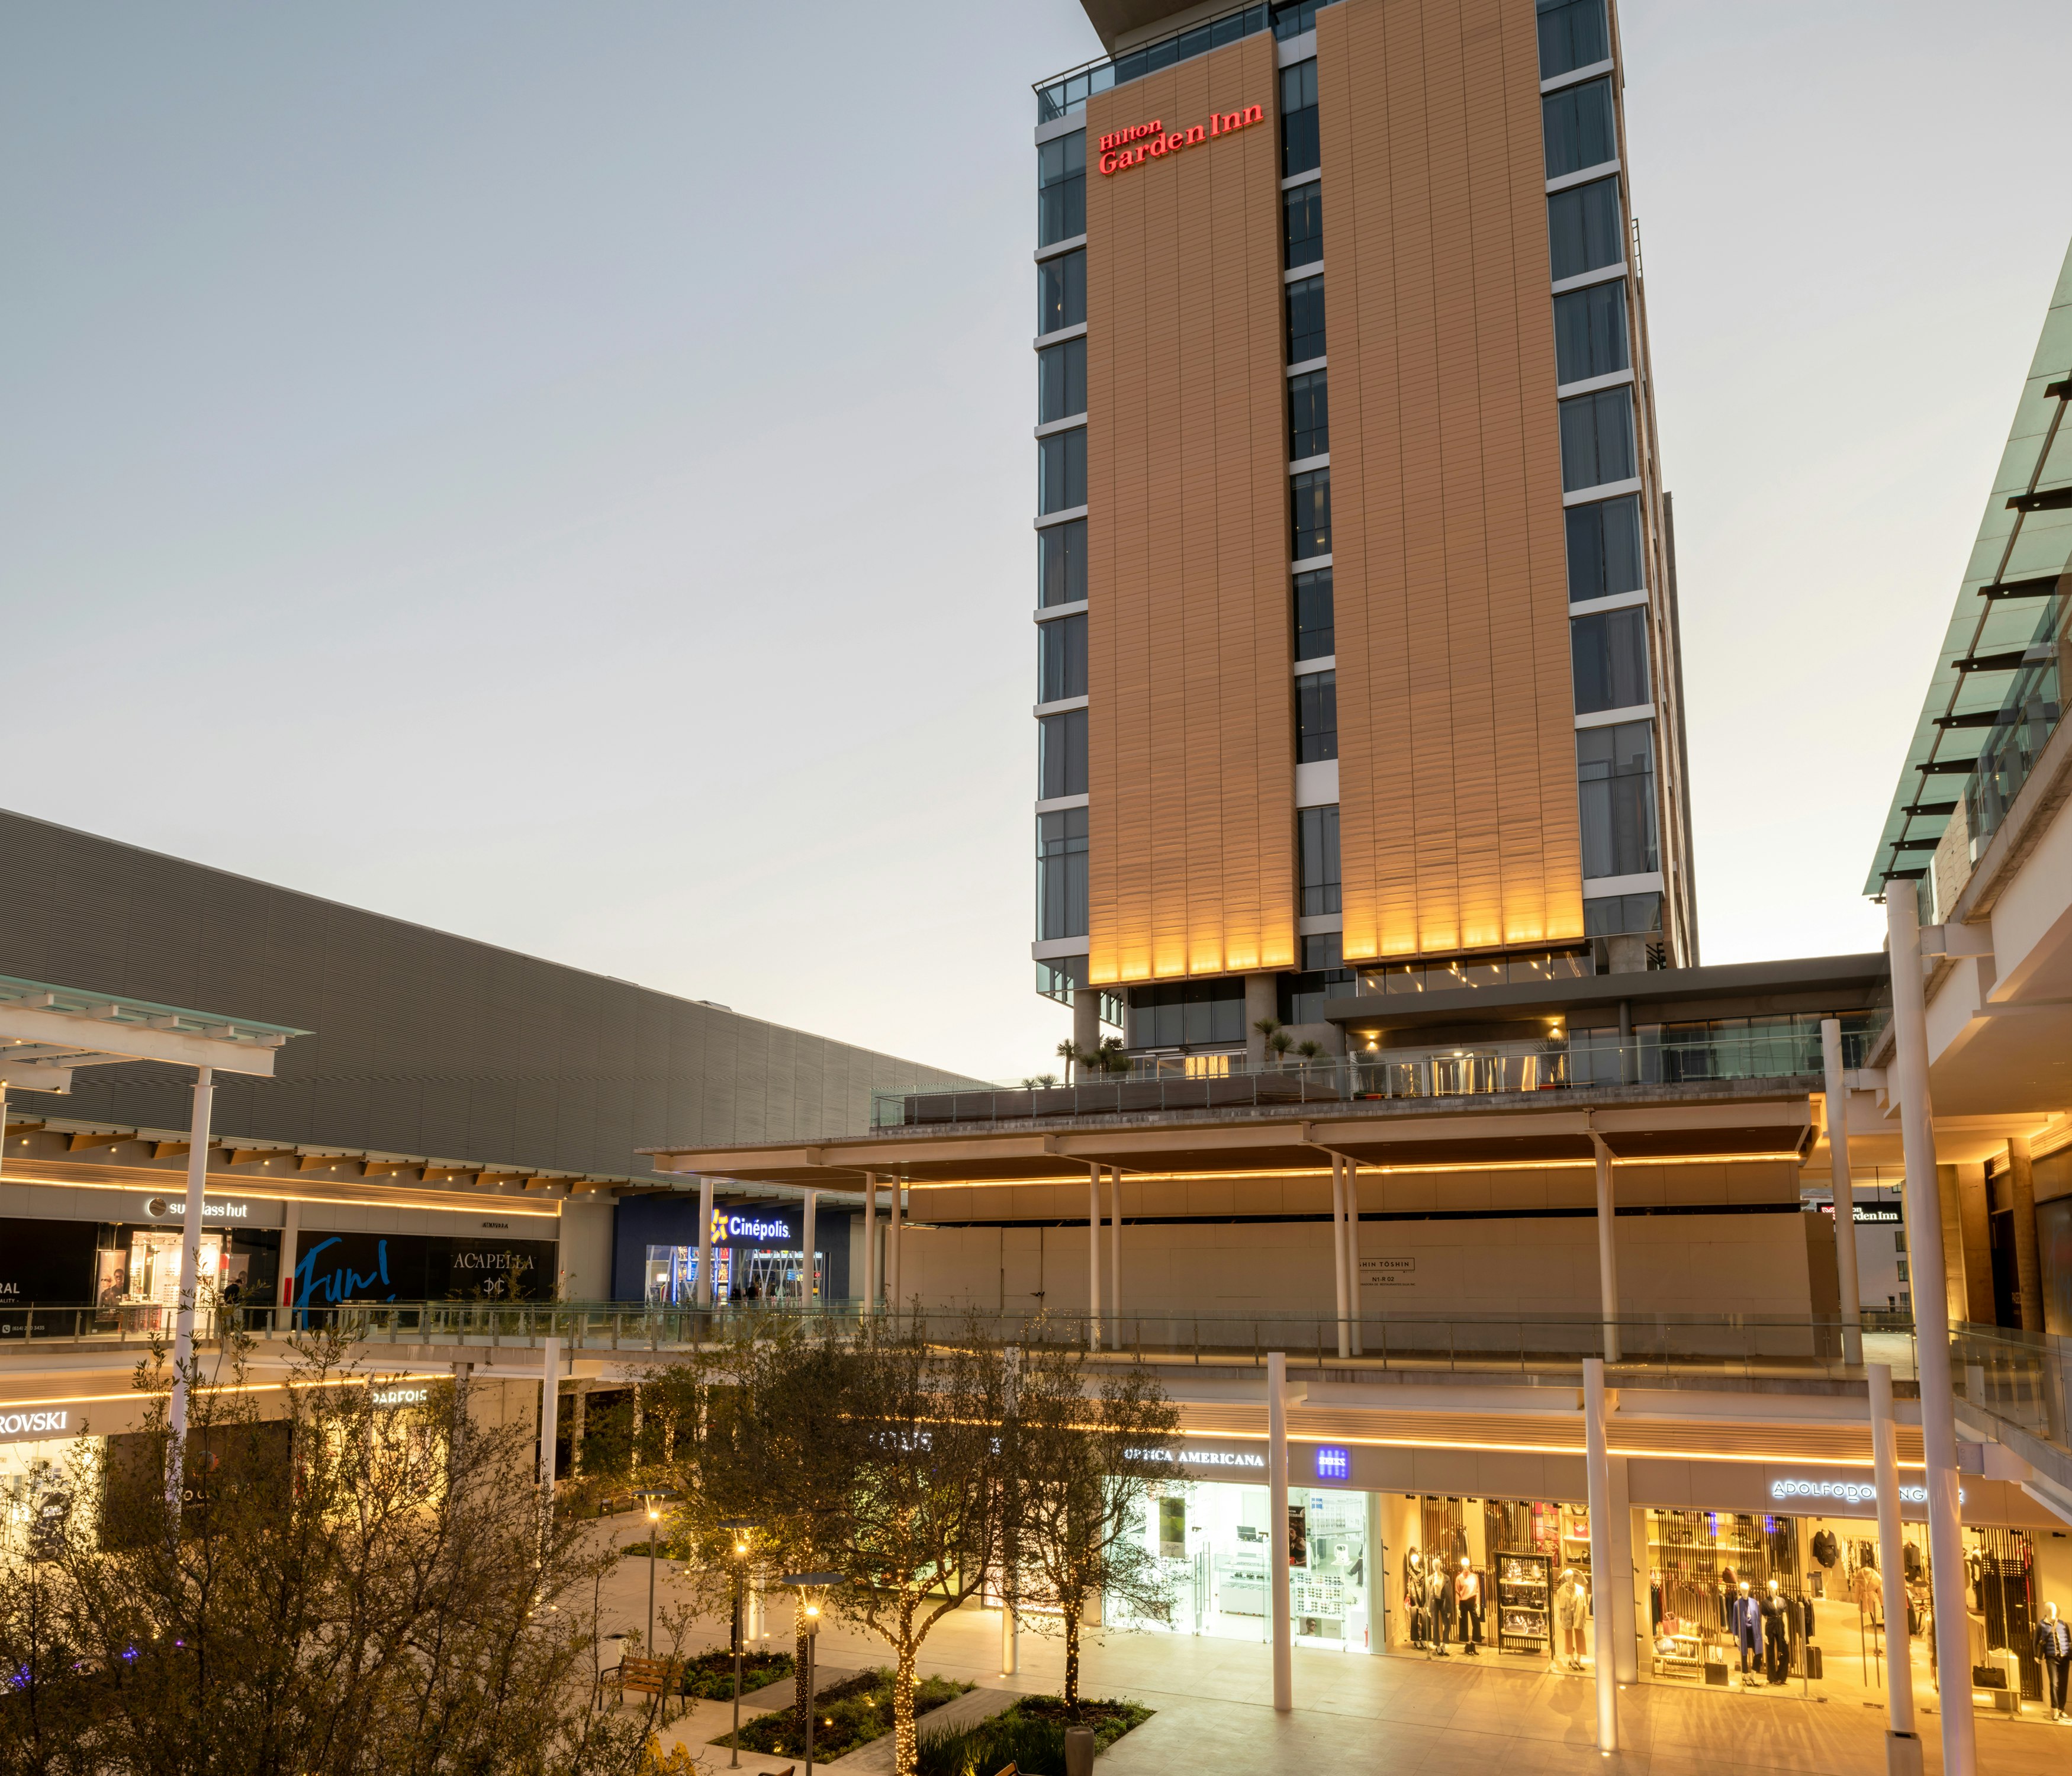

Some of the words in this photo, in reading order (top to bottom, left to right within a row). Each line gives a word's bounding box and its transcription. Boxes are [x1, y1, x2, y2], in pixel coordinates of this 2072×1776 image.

[1099, 120, 1163, 152] Hilton
[1099, 124, 1206, 175] Garden
[1210, 104, 1264, 136] Inn
[169, 1202, 224, 1216] sulass
[226, 1202, 247, 1217] hut
[1852, 1212, 1877, 1220] rden
[1877, 1211, 1898, 1220] Inn
[453, 1253, 534, 1269] ACAPELLA
[293, 1237, 396, 1330] Fun!
[1179, 1452, 1264, 1466] AMERICANA
